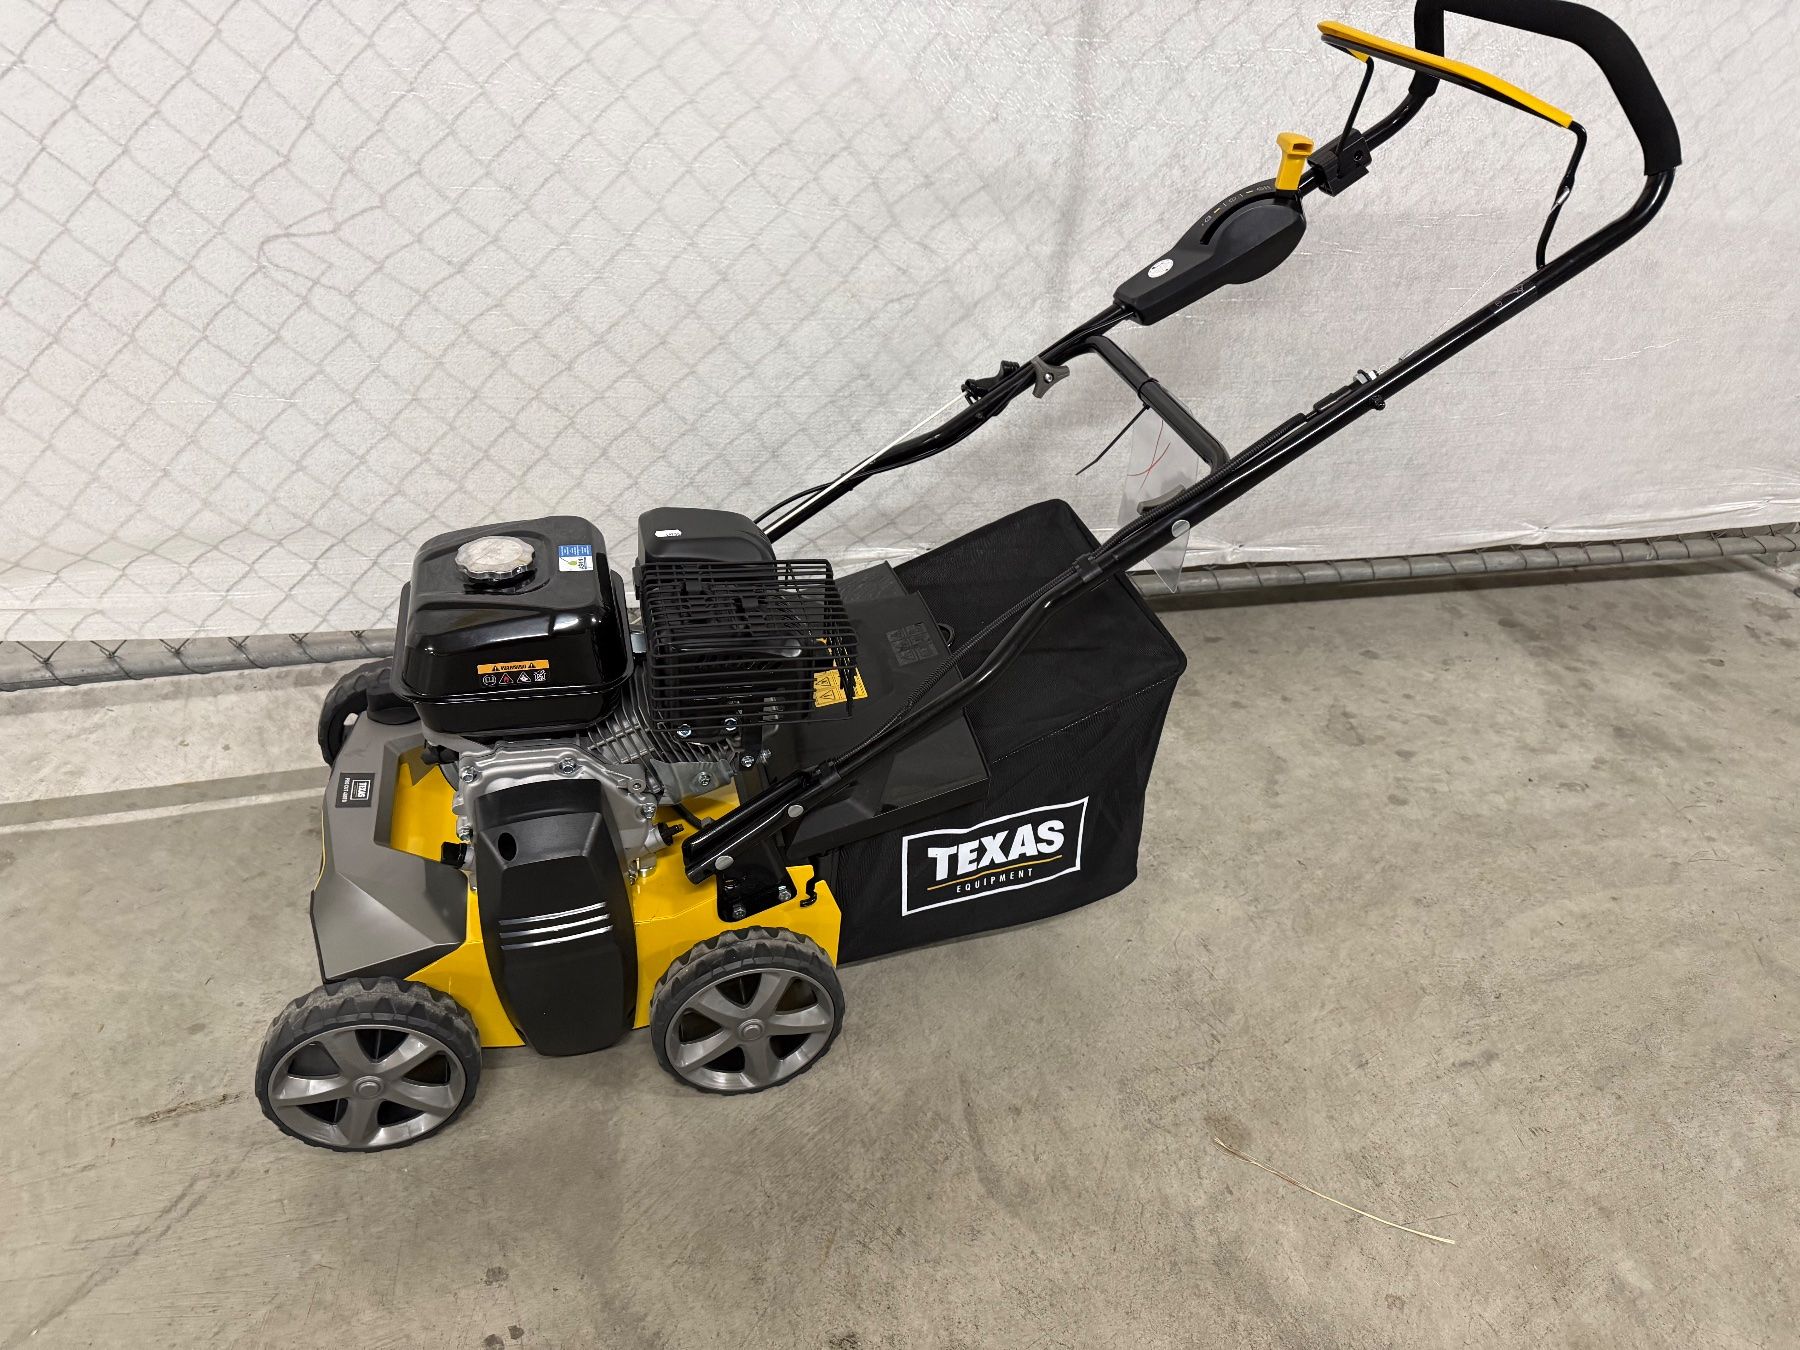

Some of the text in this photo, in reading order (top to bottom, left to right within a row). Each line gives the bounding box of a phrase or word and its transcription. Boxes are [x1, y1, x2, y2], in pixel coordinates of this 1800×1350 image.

[358, 782, 367, 797] TEXAS
[927, 819, 1065, 881] TEXAS
[956, 868, 1033, 893] EQUIPMENT
